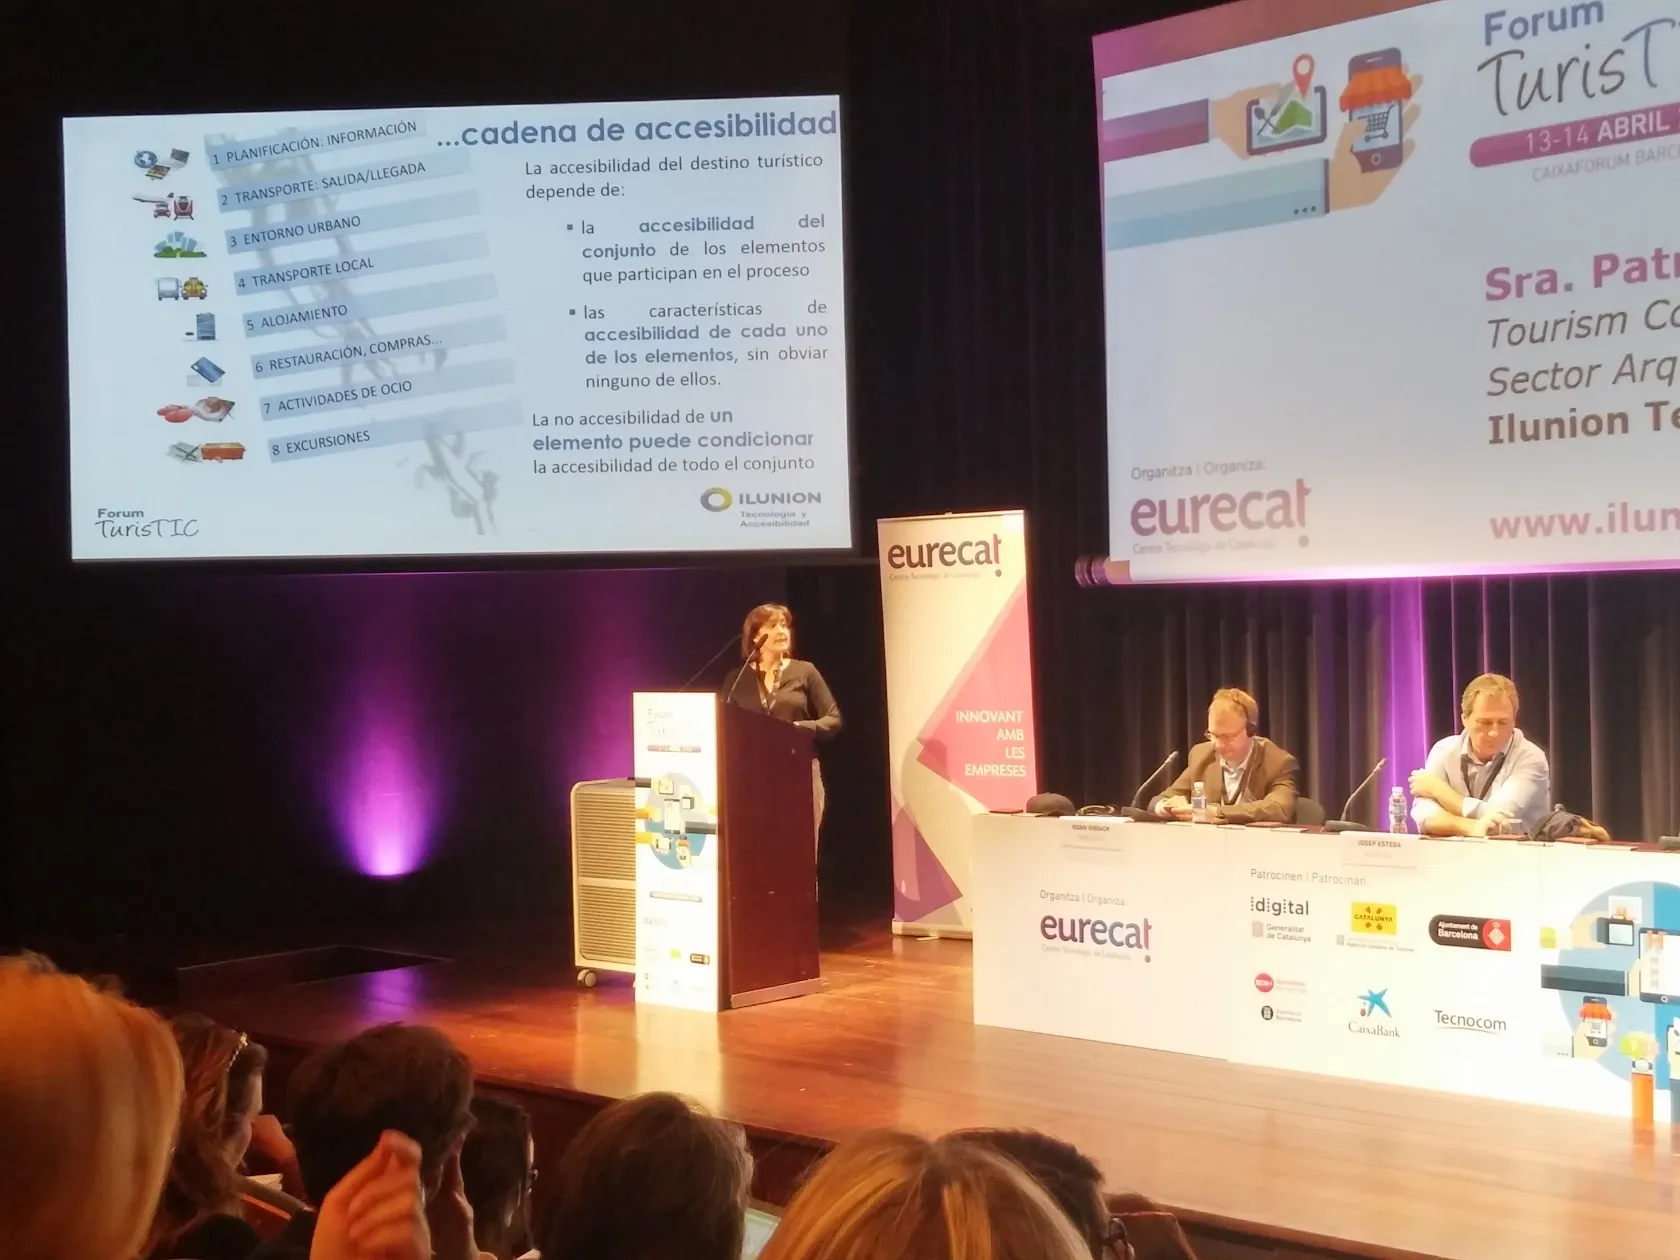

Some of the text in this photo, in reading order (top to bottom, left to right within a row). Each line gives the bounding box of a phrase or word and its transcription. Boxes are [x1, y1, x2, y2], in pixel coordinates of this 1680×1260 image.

[1484, 1, 1604, 46] Forum
[1477, 18, 1680, 117] TurisT
[586, 118, 625, 142] de
[634, 110, 837, 141] accesibilidad
[1526, 123, 1590, 154] 13-14
[1597, 110, 1671, 142] ABRIL
[213, 119, 418, 166] 1 PLANIFICACIÓN: INFORMACIÓN
[525, 152, 824, 176] La accesibilidad del destino turístico
[1532, 144, 1680, 182] CAIXAFORUM BARC
[221, 161, 427, 206] 2 TRANSPORTE: SALIDA/LLEGADA
[525, 182, 626, 201] depende de:
[230, 215, 361, 248] 3 ENTORNO URBANO
[581, 213, 826, 234] la accesibilidad del
[582, 238, 826, 261] conjunto de los elementos
[238, 257, 375, 290] 4 TRANSPORTE LOCAL
[583, 264, 810, 286] que participan en el proceso
[1485, 264, 1574, 302] Sra.
[246, 304, 349, 331] 5 ALOJAMIENTO
[584, 300, 827, 320] las características de
[584, 322, 828, 342] accesibilidad de cada uno
[1488, 308, 1628, 349] Tourism
[255, 334, 443, 373] 6 RESTAURACIÓN, COMPRAS...
[585, 345, 829, 365] de los elementos, sin obviar
[585, 371, 721, 391] ninguno de ellos.
[1487, 353, 1678, 397] Sector Arq
[263, 380, 413, 414] 7 ACTIVIDADES DE OCIO
[533, 408, 733, 427] La no accesibilidad de un
[1489, 407, 1629, 445] Ilunion
[272, 430, 371, 457] 8 EXCURSIONES
[532, 430, 814, 452] elemento puede condicionar
[533, 455, 815, 474] la accesibilidad de todo el conjunto
[1131, 465, 1192, 481] Organitza
[739, 492, 821, 504] ILUNION
[97, 508, 144, 519] Forum
[1130, 478, 1311, 547] eurecat
[95, 518, 200, 539] TurisTIC
[888, 534, 1002, 577] eurecat
[955, 710, 1023, 723] INNOVANT
[996, 728, 1024, 741] AMB
[1005, 746, 1025, 759] LES
[964, 764, 1026, 777] EMPRESES
[1250, 868, 1303, 882] Patrocinen
[1039, 889, 1080, 902] Organitza
[1353, 914, 1394, 923] CATALUNYA
[1040, 914, 1152, 963] eurecat
[1276, 932, 1312, 944] Catalunya
[1437, 929, 1479, 940] Barcelona
[1348, 1021, 1400, 1038] CaixaBank
[1434, 1010, 1507, 1031] Tecnocom
